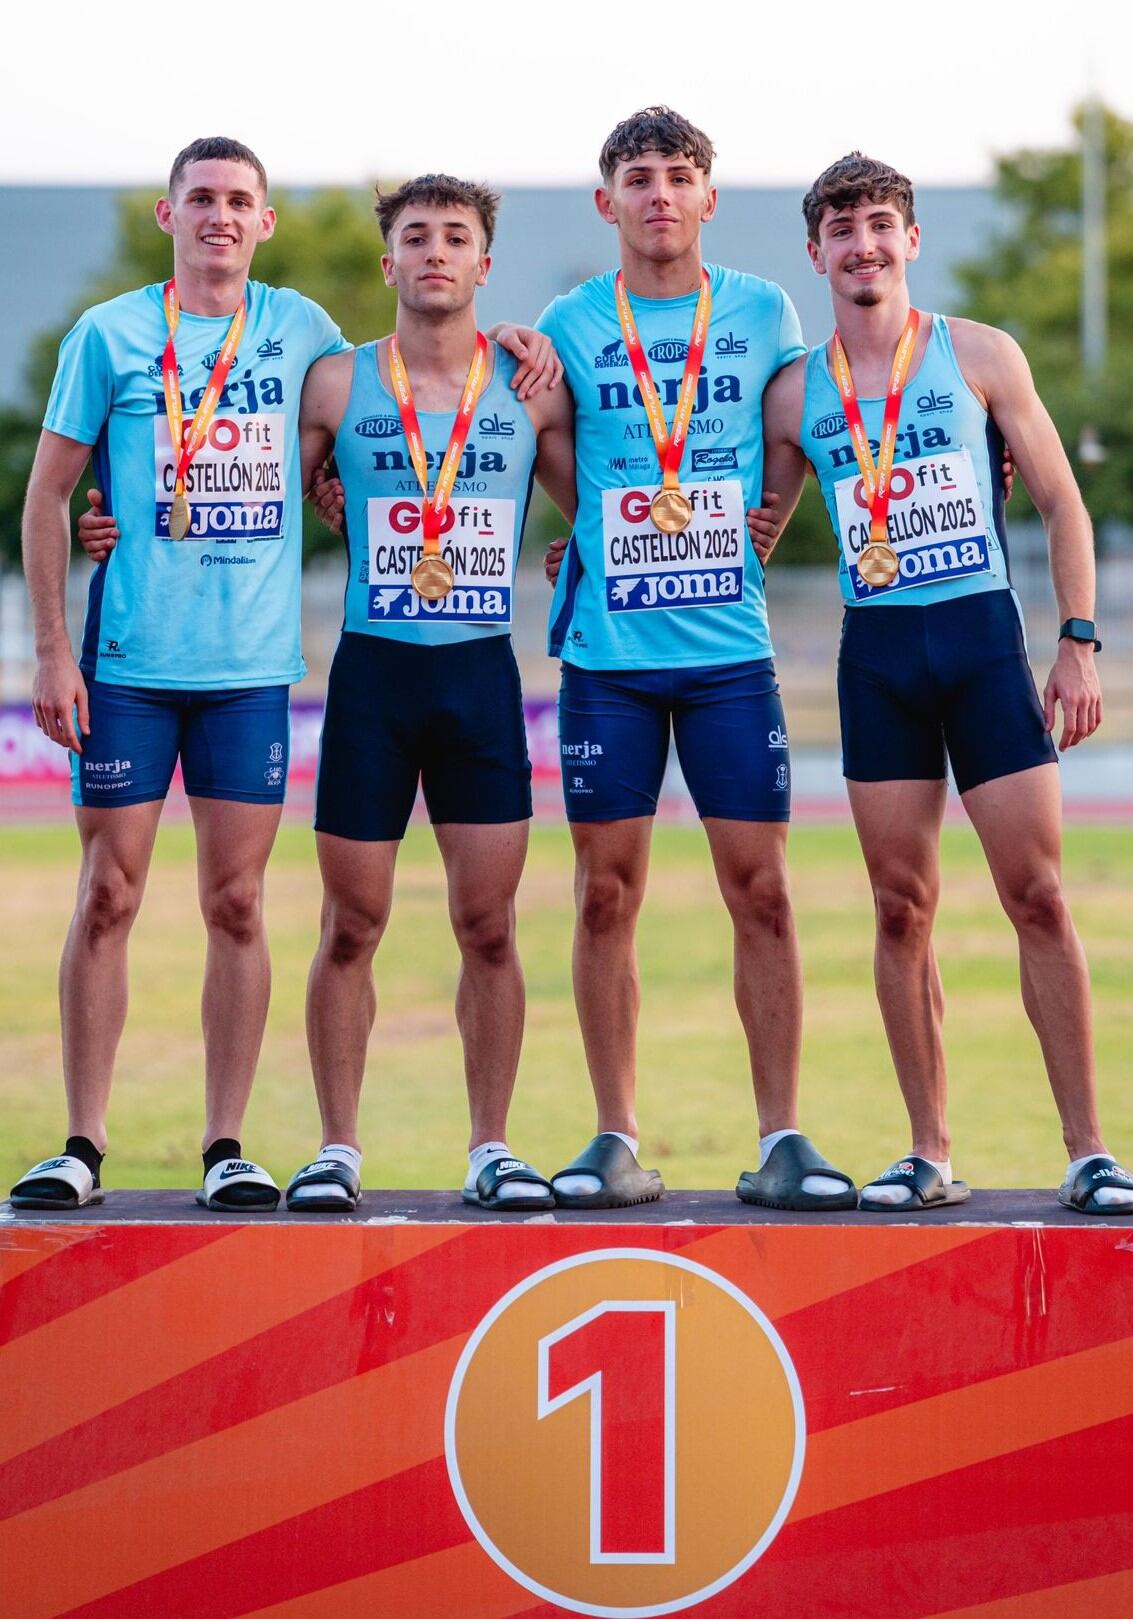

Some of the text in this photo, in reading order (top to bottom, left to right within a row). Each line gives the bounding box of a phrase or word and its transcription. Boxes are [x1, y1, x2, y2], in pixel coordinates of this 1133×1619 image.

[650, 343, 690, 360] TROPS
[596, 366, 742, 414] nerja
[372, 443, 507, 478] nerja
[255, 462, 280, 492] 2025
[848, 497, 977, 554] CAELLÓN 2025
[703, 528, 738, 559] 2025
[470, 547, 506, 577] 2025
[561, 740, 604, 759] nerja
[85, 759, 132, 774] nerja
[225, 1161, 257, 1172] NIKE
[306, 1161, 338, 1172] NIKE
[499, 1160, 528, 1170] NIKE
[537, 1300, 677, 1565] 1
